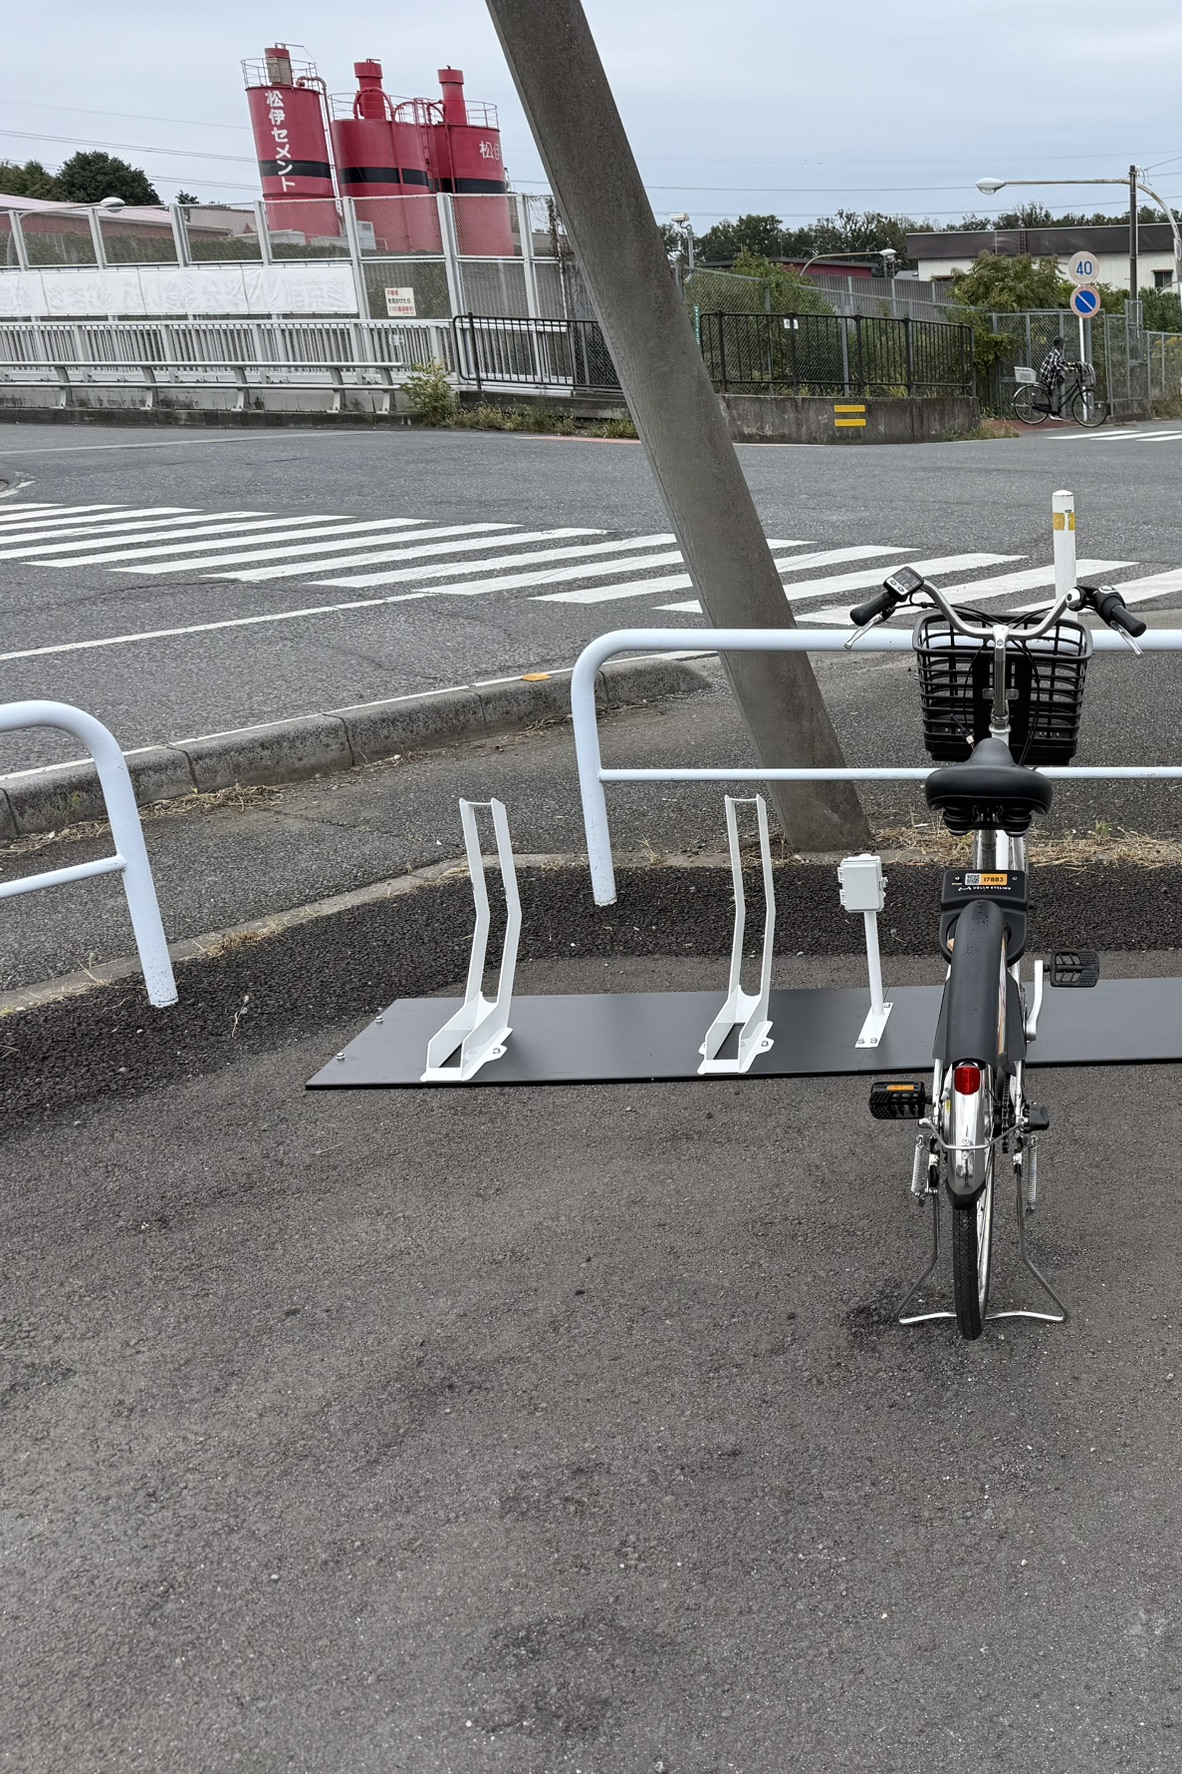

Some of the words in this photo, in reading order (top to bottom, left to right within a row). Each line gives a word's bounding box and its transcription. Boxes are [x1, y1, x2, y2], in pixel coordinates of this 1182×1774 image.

[265, 90, 296, 193] 松伊セメント
[1076, 260, 1092, 275] 40
